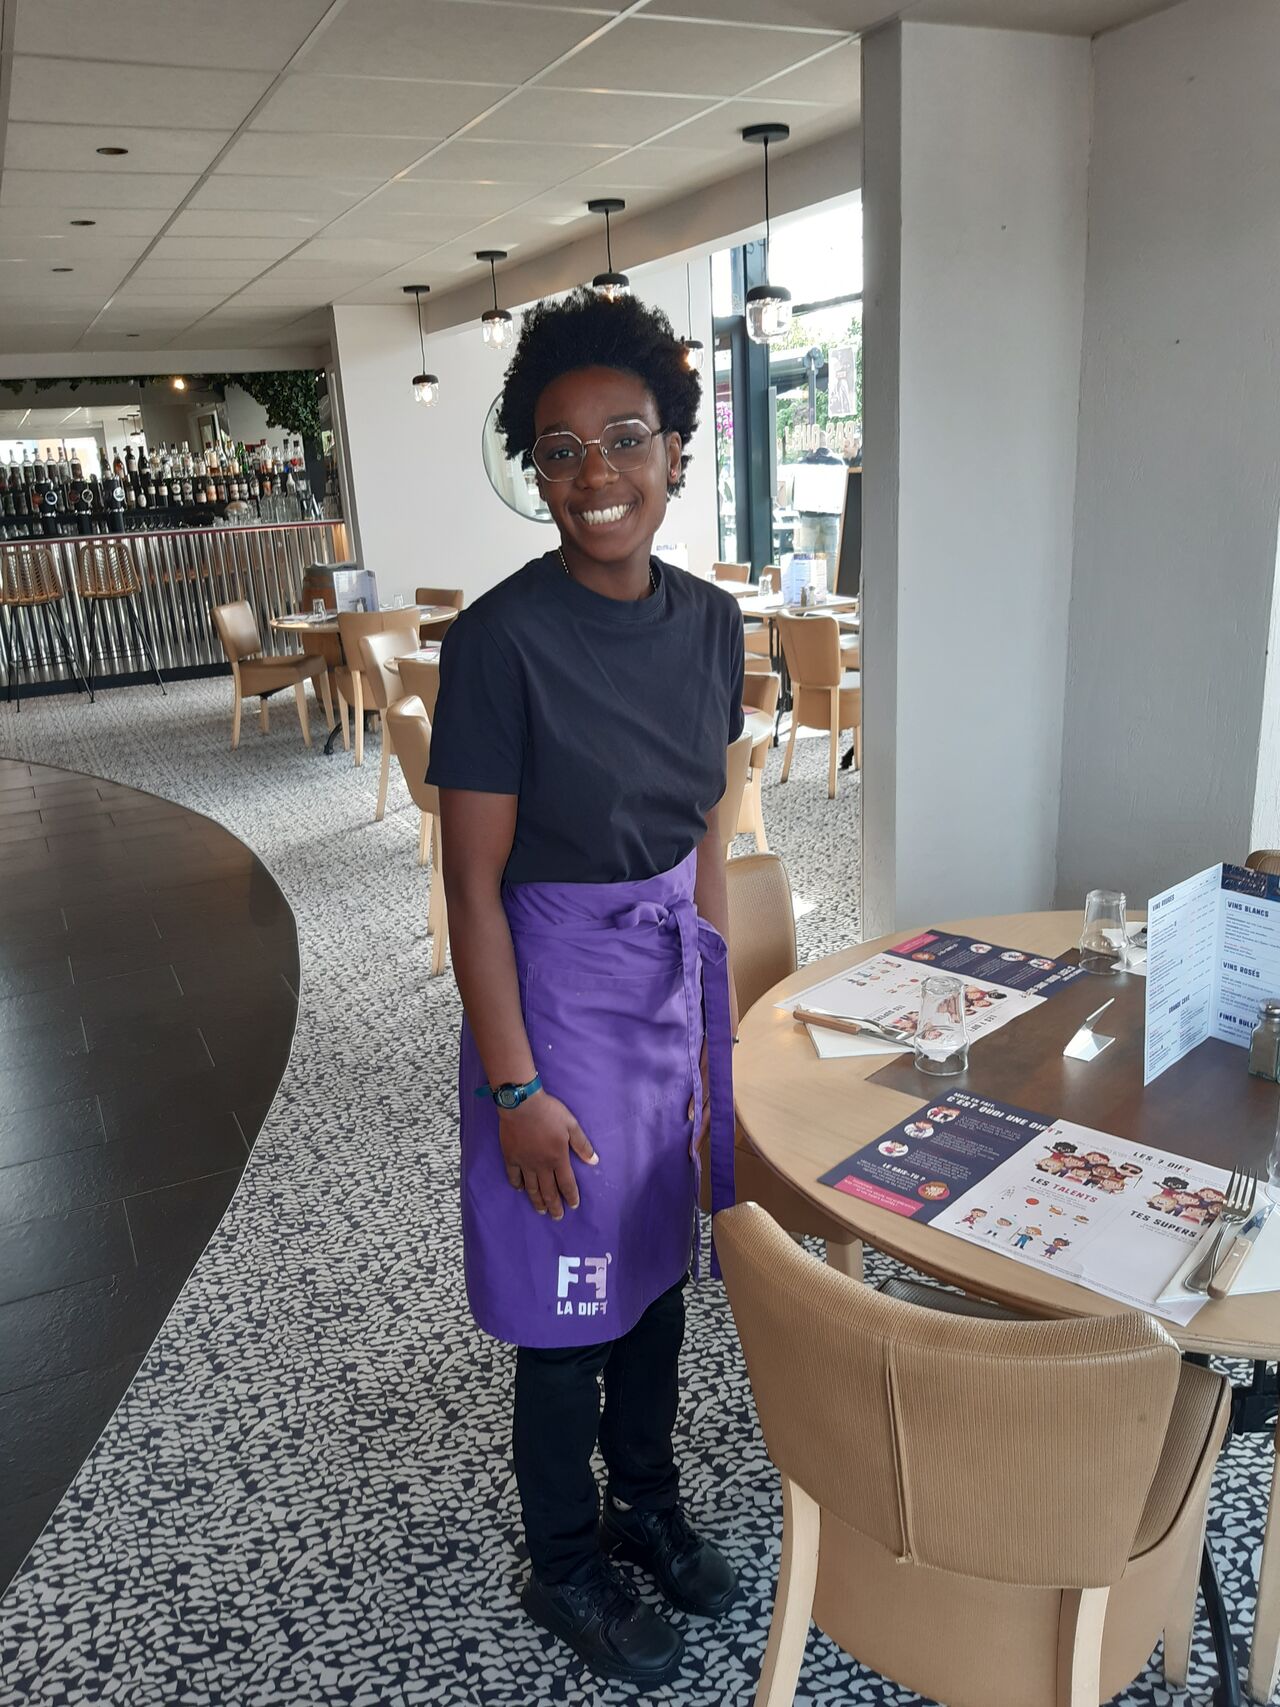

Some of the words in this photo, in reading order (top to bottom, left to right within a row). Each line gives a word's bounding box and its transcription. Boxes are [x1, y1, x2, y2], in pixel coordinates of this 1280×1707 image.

[1227, 901, 1243, 911] VINS
[1244, 905, 1269, 917] BLANCS
[1223, 961, 1238, 971] VINS
[946, 1095, 978, 1109] C'EST
[978, 1106, 1005, 1118] QUOI
[1005, 1114, 1028, 1126] UNE
[1133, 1151, 1153, 1161] LES
[1030, 1176, 1050, 1187] LES
[1052, 1183, 1098, 1203] TALENTS
[1130, 1210, 1151, 1222] TES
[1153, 1219, 1198, 1238] SUPERS
[557, 1301, 573, 1316] LA
